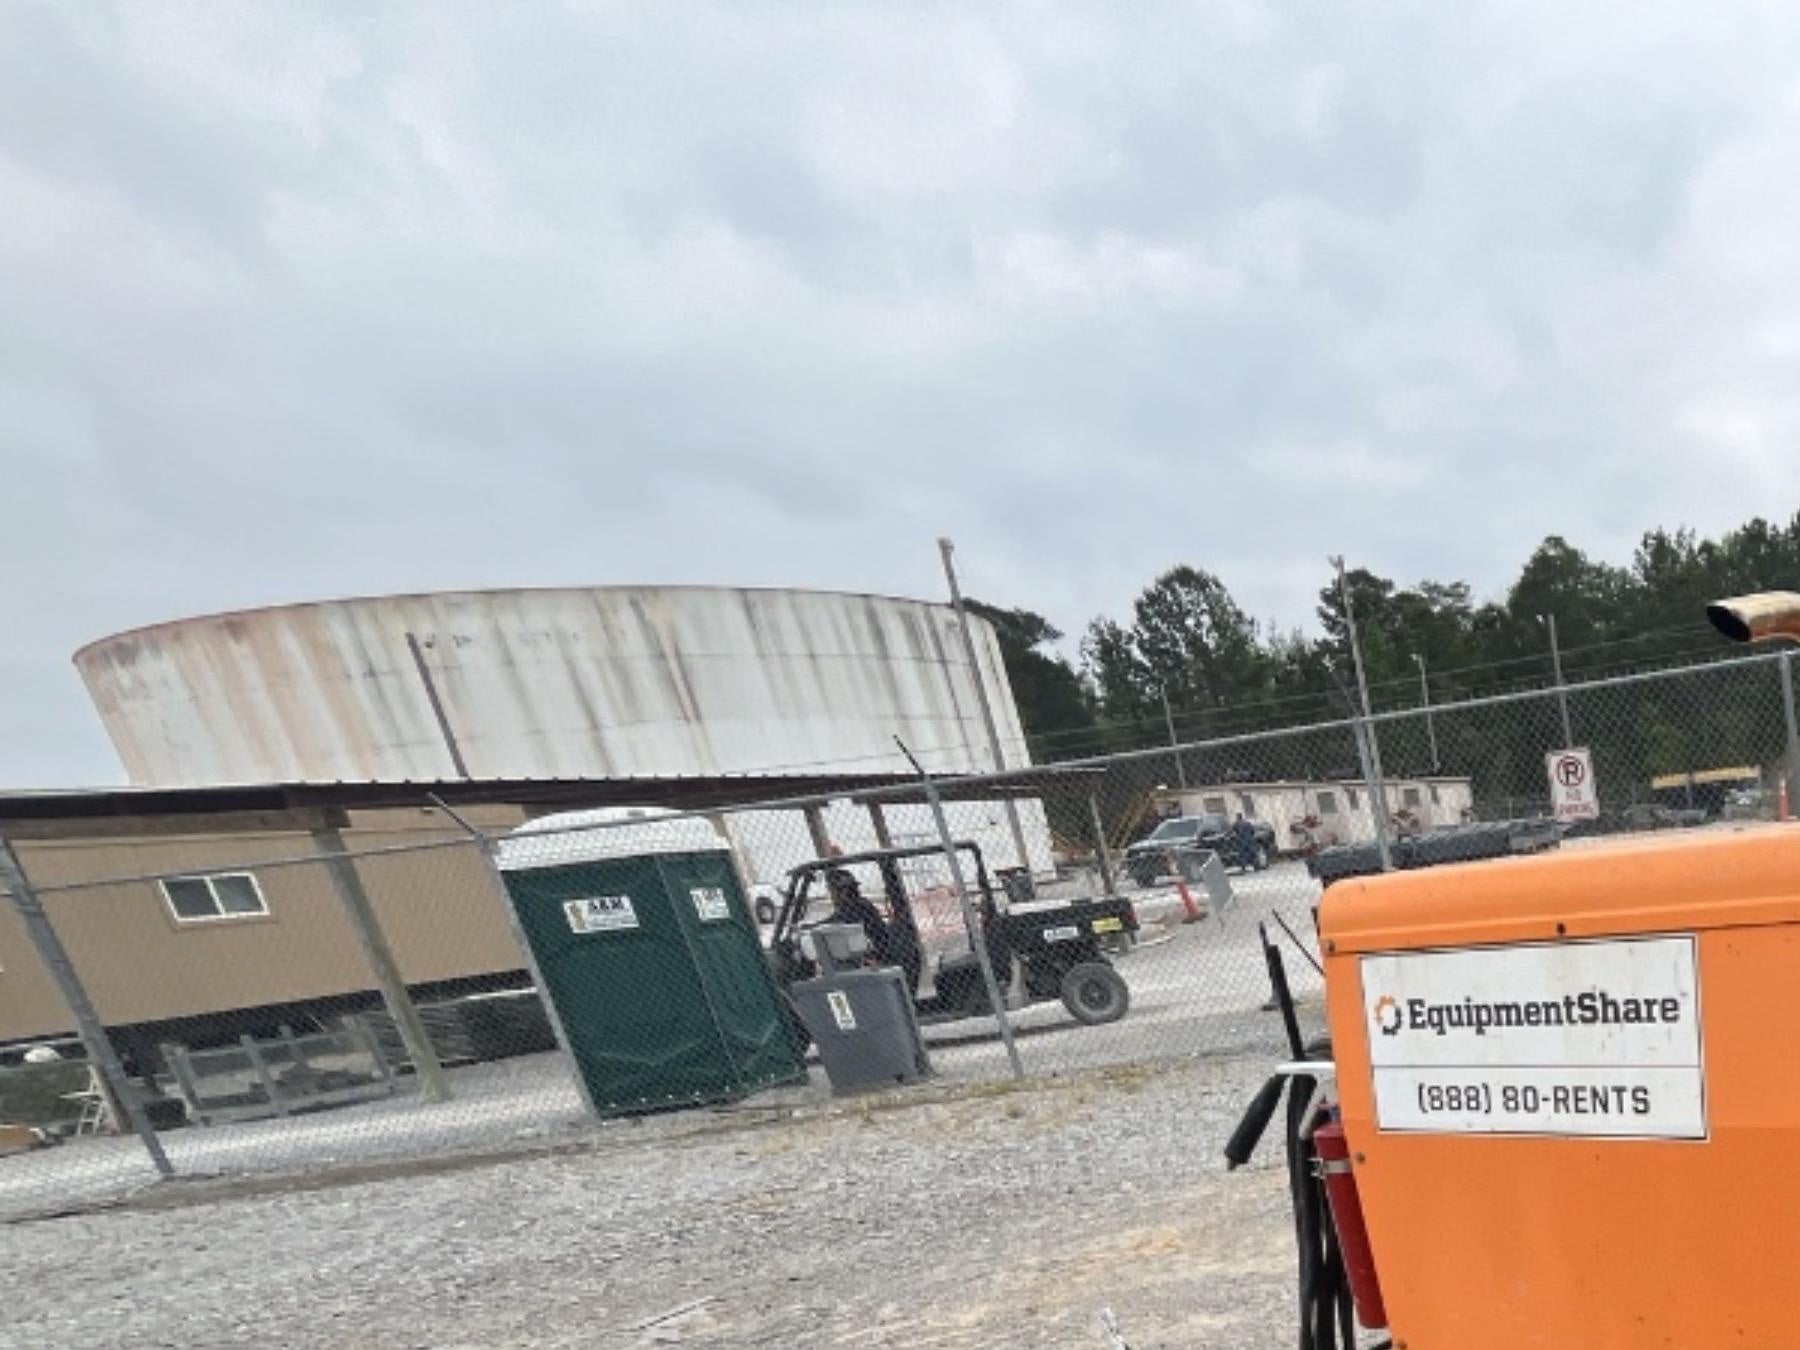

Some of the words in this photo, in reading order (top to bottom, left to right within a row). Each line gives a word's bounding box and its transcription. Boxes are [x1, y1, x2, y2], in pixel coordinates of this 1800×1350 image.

[1408, 992, 1681, 1035] EquipmentShare
[1418, 1082, 1492, 1114] (888)
[1502, 1084, 1651, 1115] 80-RENTS
